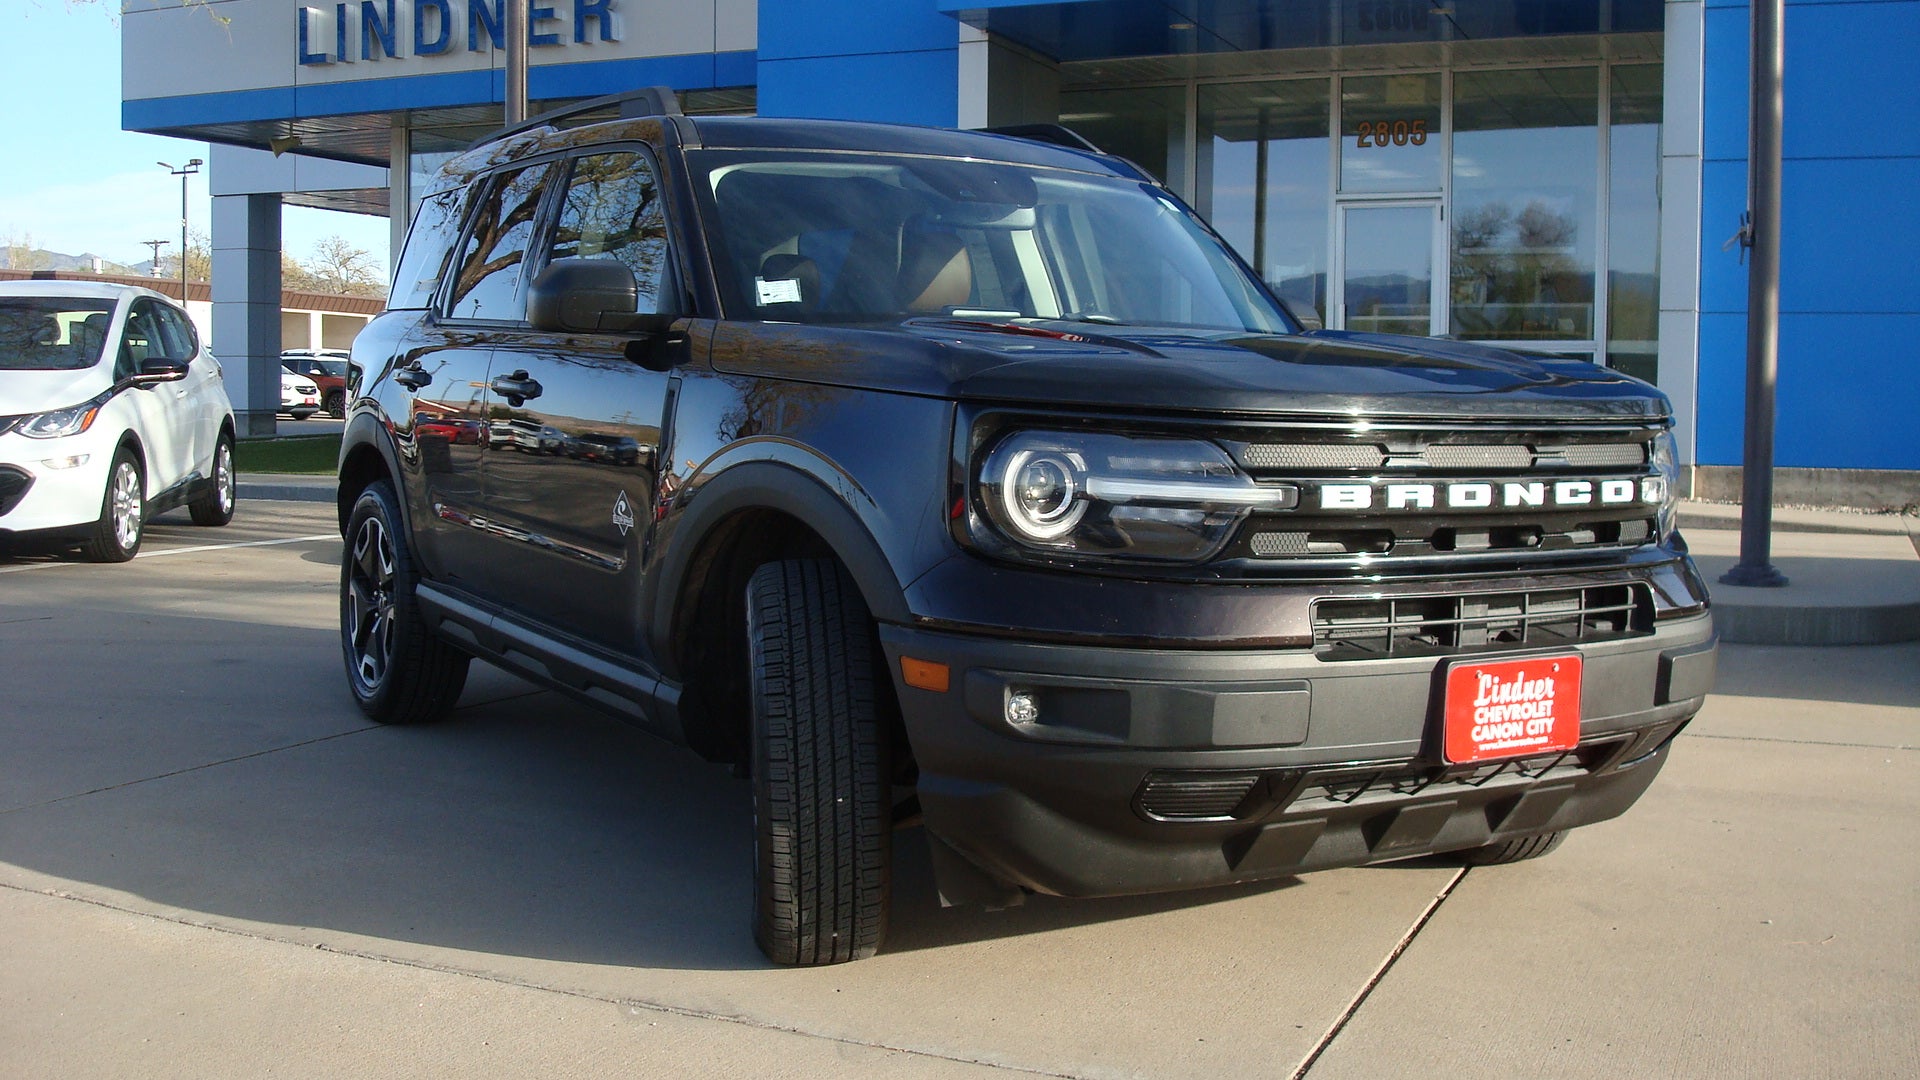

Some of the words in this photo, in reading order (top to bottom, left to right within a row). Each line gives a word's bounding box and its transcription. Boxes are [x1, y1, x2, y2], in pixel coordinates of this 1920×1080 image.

[299, 0, 622, 66] LINDNER
[1357, 120, 1427, 148] 2805
[1320, 480, 1635, 509] BRONCO
[1473, 671, 1556, 707] Lindner
[1474, 700, 1554, 725] CHEVROLET
[1471, 721, 1523, 742] CANON
[1526, 717, 1555, 735] CITY
